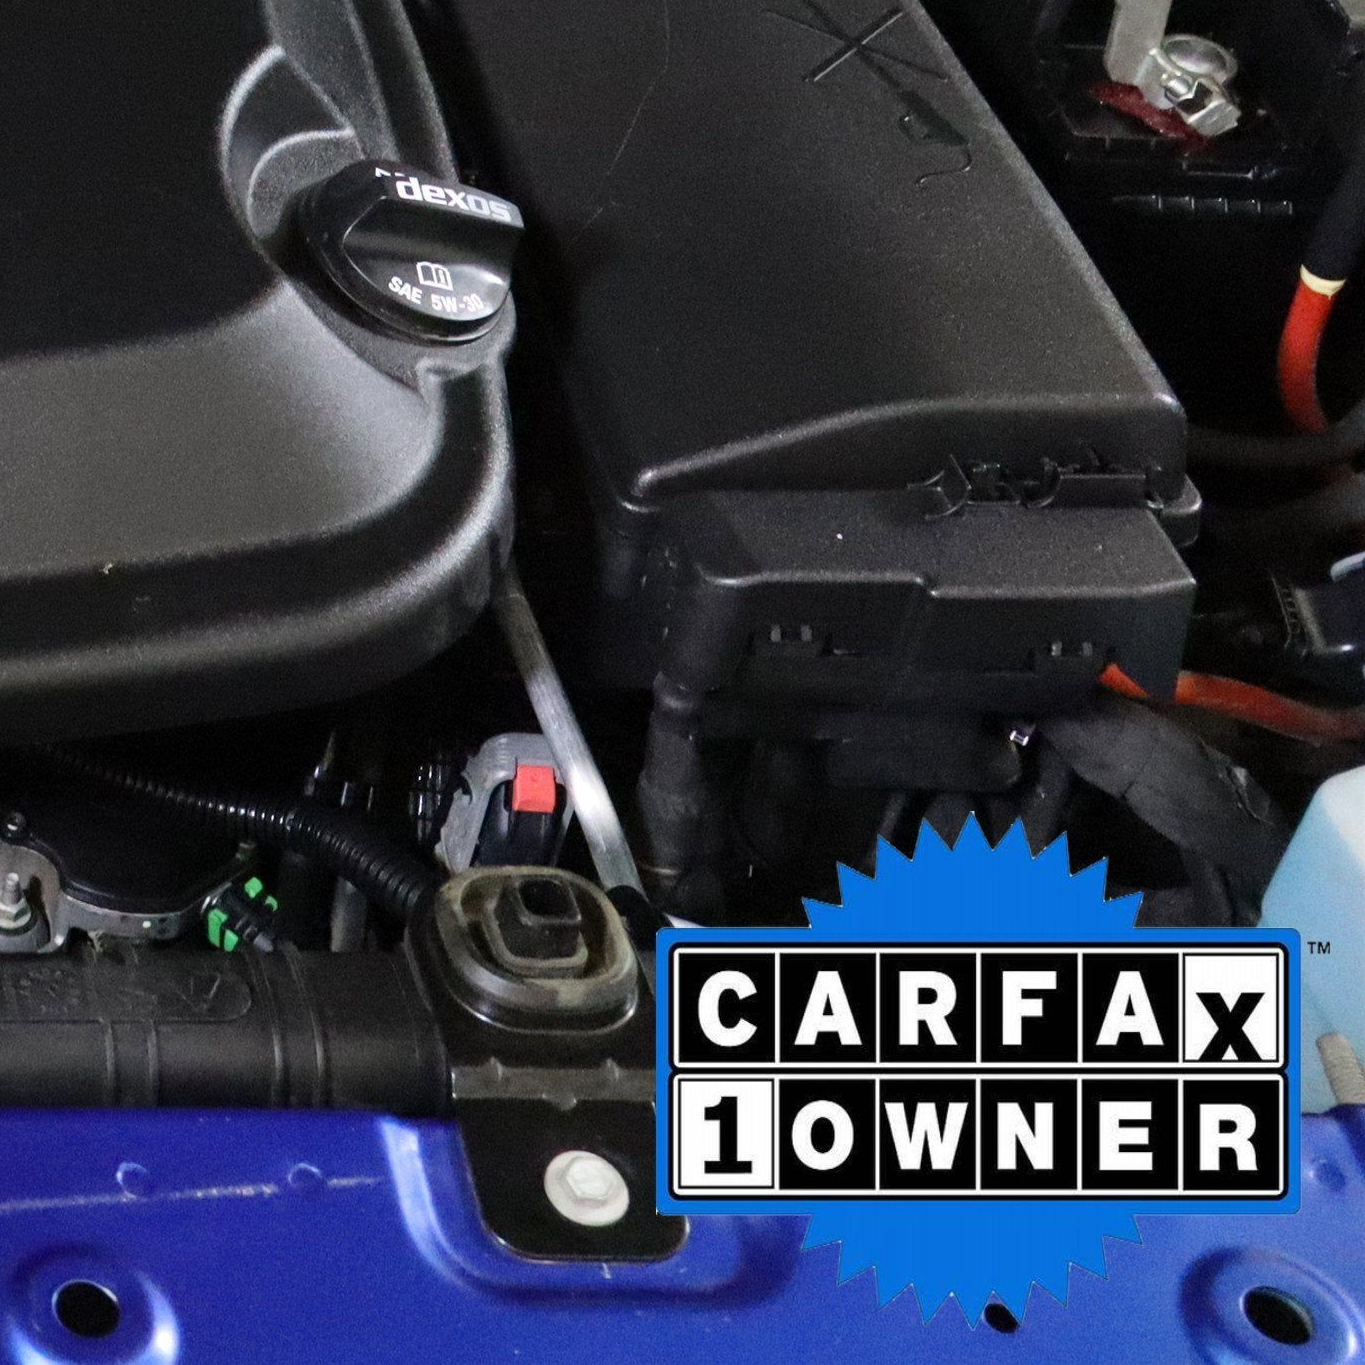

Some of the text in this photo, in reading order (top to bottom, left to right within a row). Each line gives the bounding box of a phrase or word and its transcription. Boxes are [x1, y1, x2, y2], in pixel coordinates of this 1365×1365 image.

[395, 177, 512, 222] dexos
[388, 276, 485, 314] SAE 5W-30
